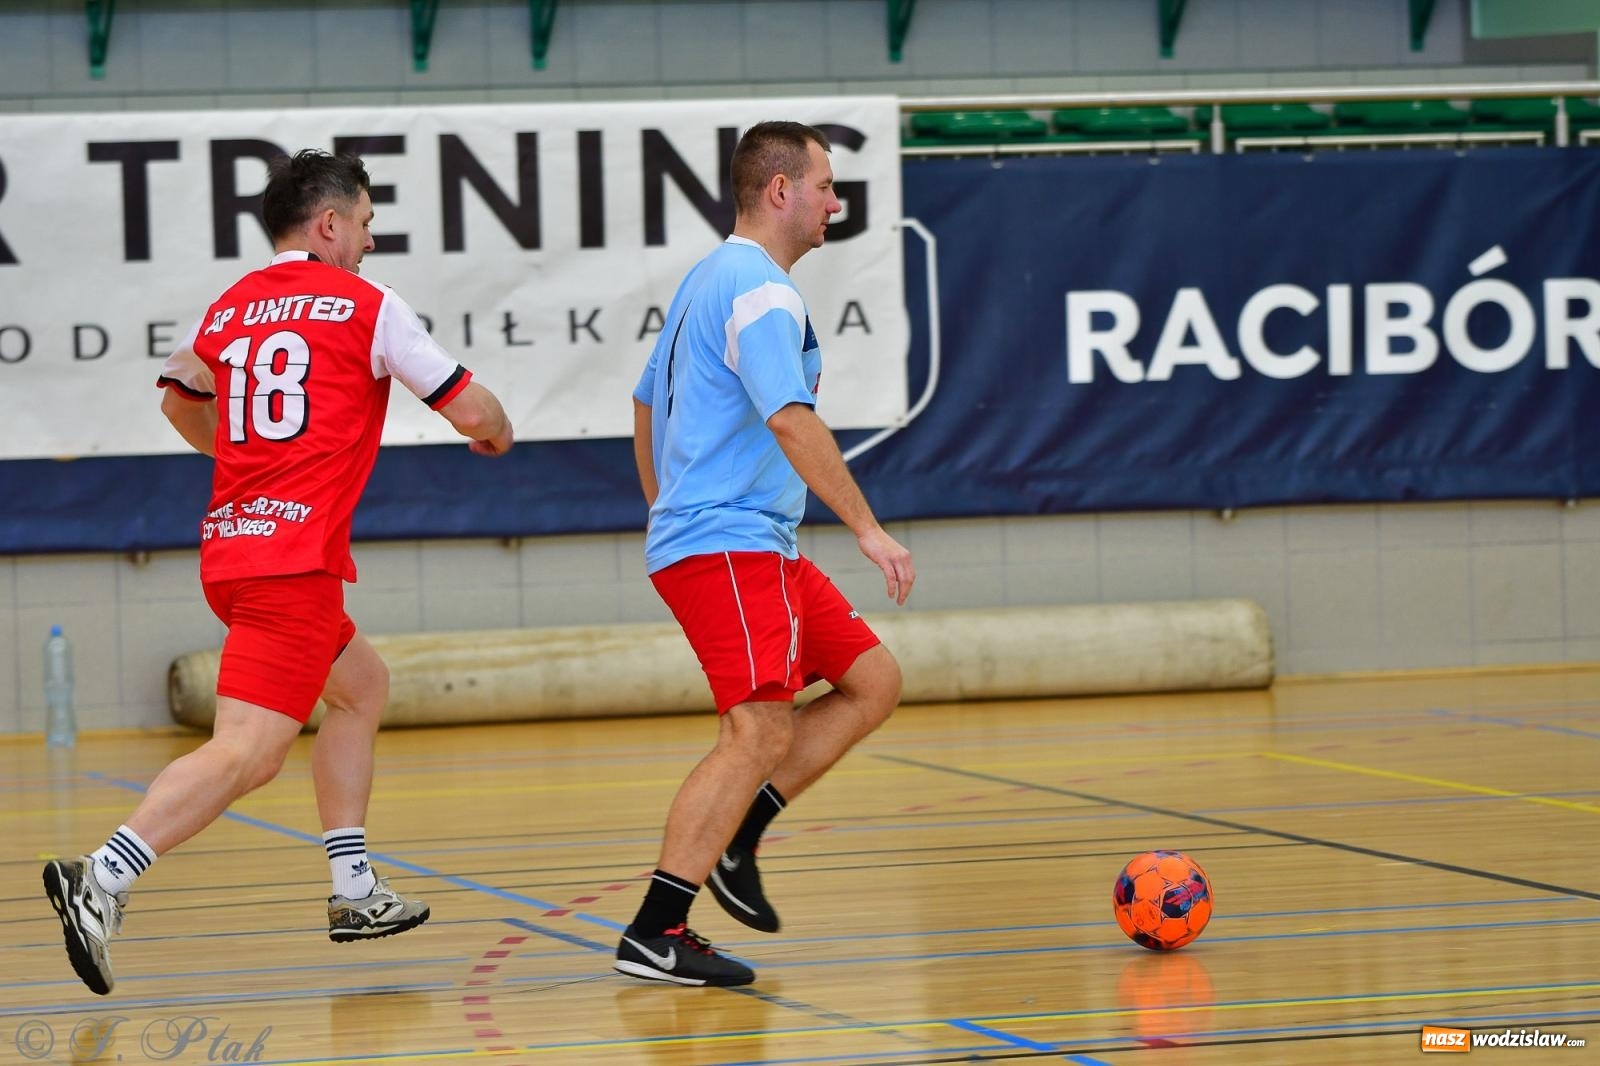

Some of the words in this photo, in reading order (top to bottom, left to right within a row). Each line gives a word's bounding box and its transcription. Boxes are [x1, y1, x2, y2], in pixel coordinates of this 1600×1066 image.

[204, 307, 236, 336] AP
[242, 294, 356, 327] UNITED
[218, 330, 311, 444] 18
